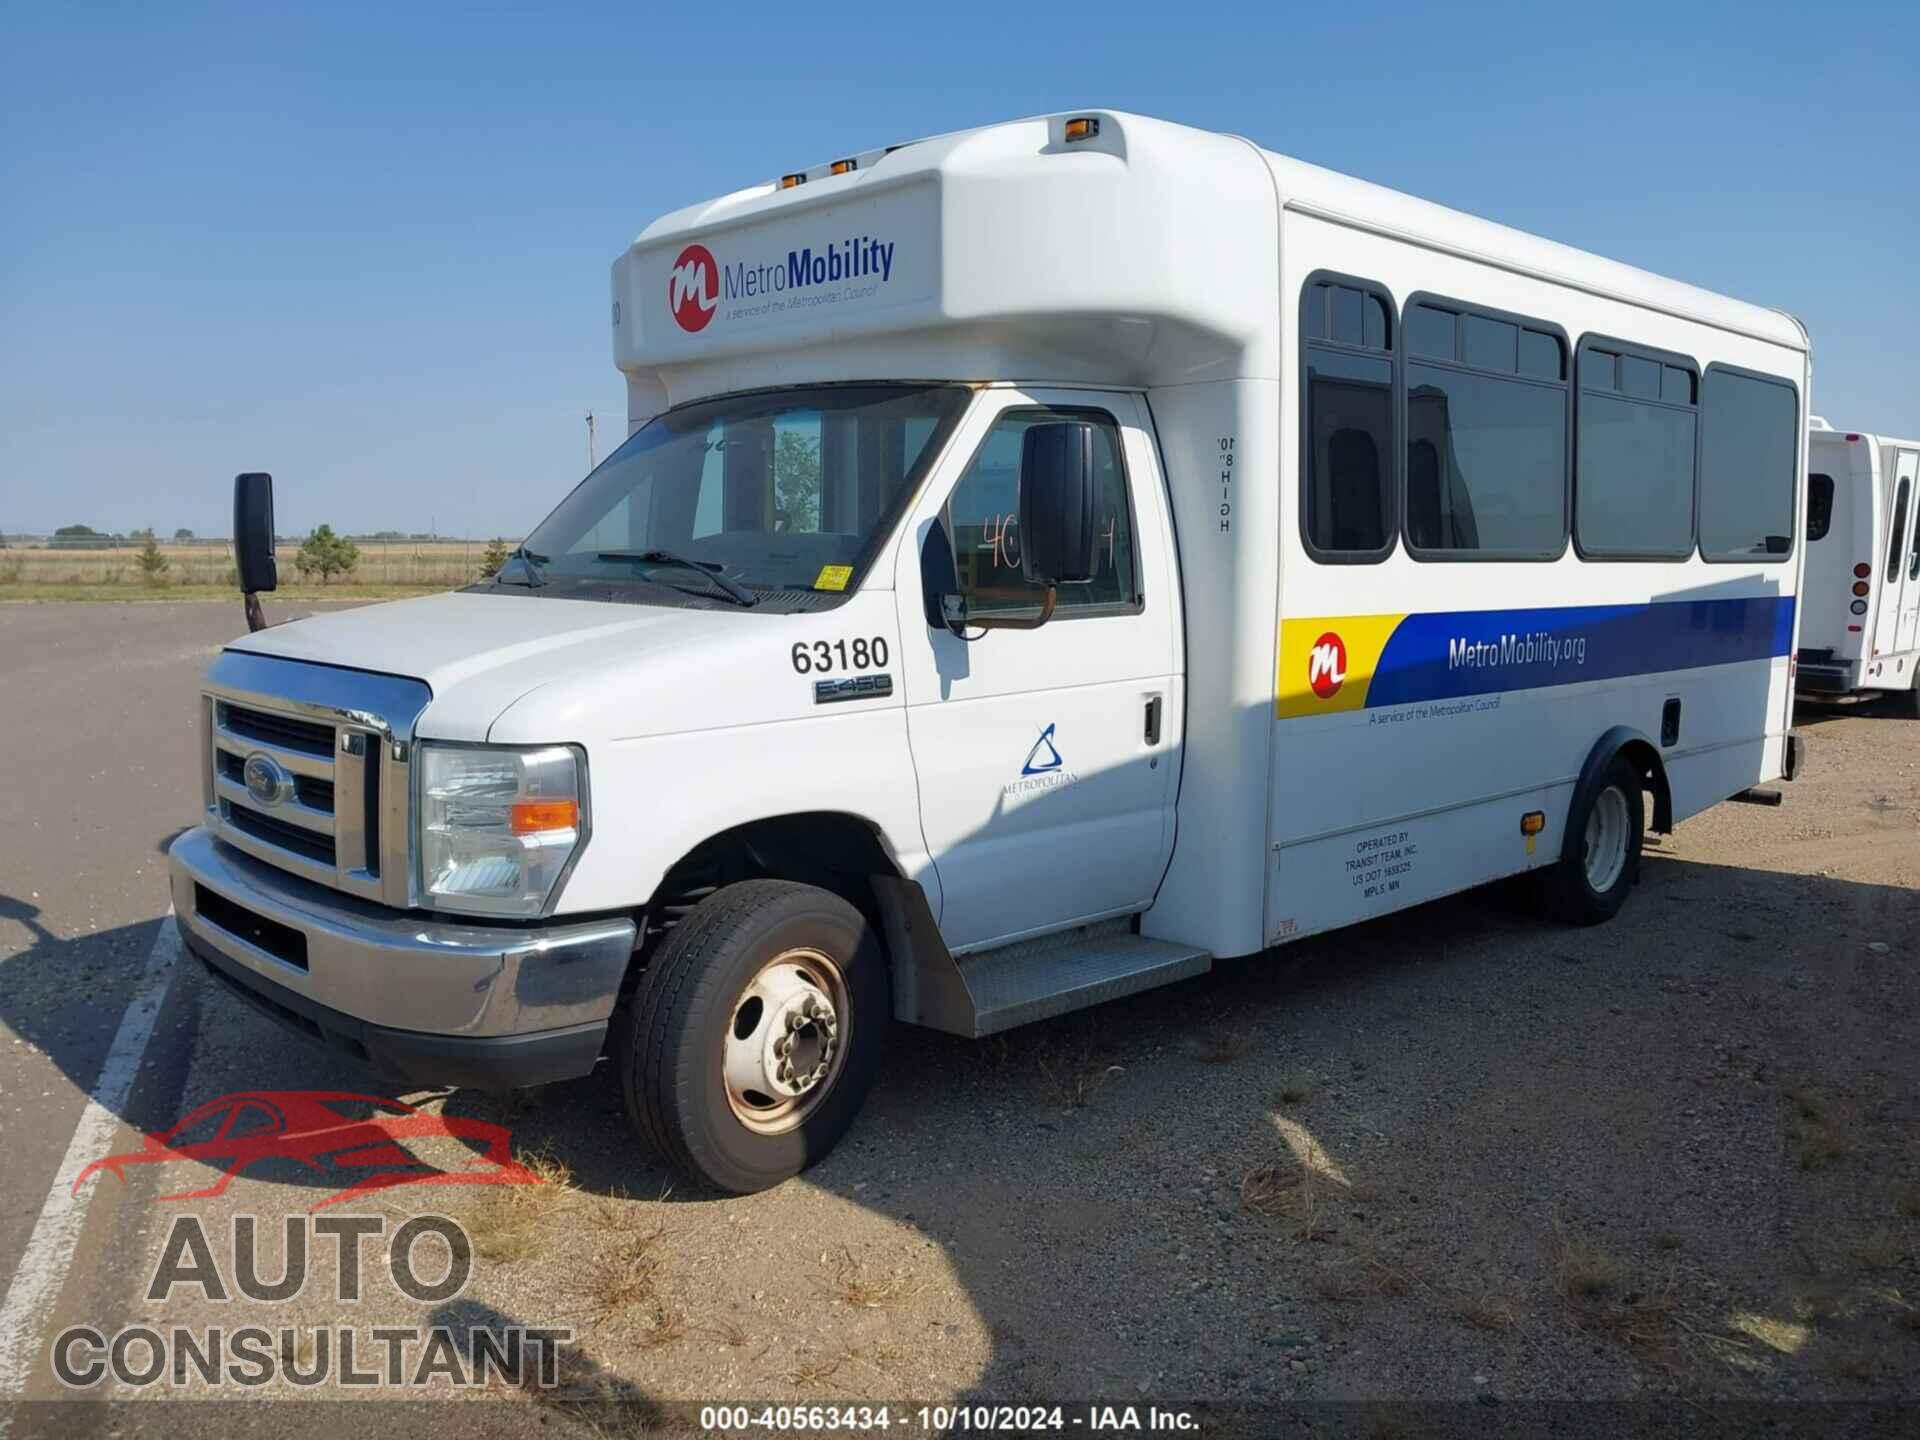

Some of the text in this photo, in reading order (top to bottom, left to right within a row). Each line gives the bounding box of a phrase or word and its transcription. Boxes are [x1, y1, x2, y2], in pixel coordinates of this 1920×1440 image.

[725, 237, 894, 300] MetroMobility
[791, 636, 889, 675] 63180
[1449, 632, 1586, 671] MetroMobility.org
[1378, 709, 1405, 724] service
[1406, 707, 1415, 720] of
[1416, 707, 1429, 720] the
[1430, 699, 1474, 719] Metropolitan
[1475, 697, 1500, 712] Council
[1002, 772, 1079, 794] METROPOLITAN
[1356, 832, 1409, 854] OPERATED BY
[1345, 854, 1379, 873] TRANSIT
[1365, 869, 1382, 882] DOT
